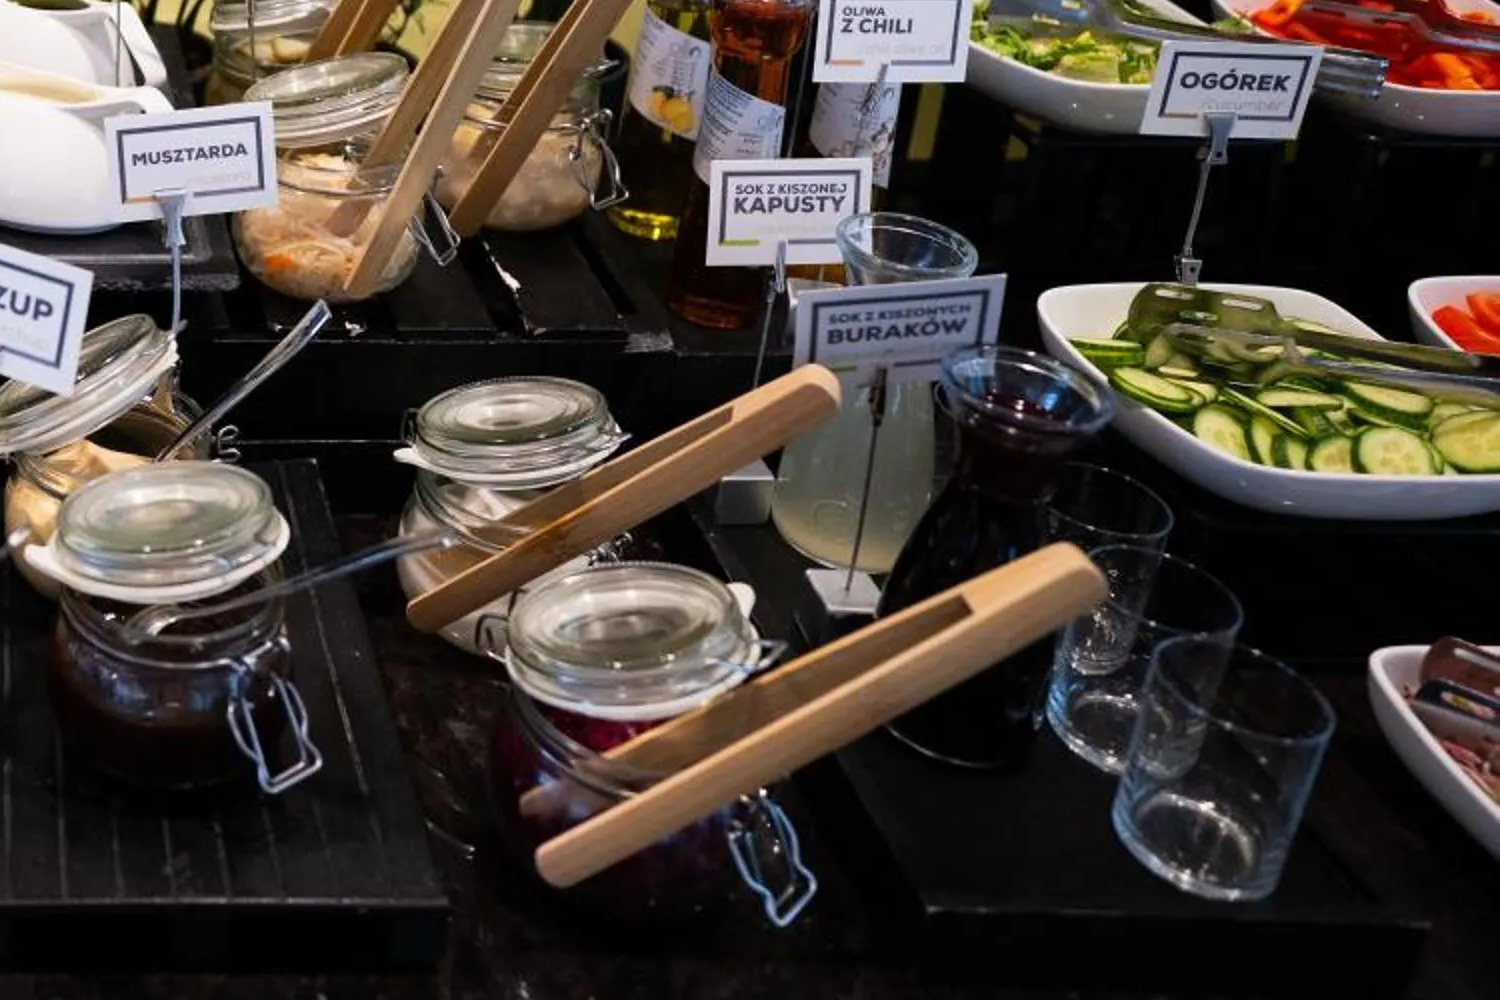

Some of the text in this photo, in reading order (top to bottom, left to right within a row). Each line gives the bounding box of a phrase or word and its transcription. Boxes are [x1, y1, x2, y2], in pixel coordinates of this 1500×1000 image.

[842, 6, 886, 17] OLIWA
[840, 18, 913, 34] Z CHILI
[1180, 68, 1292, 93] OGÓREK
[132, 143, 248, 167] MUSZTARDA
[735, 183, 848, 195] SOK Z KISZONEJ
[733, 195, 846, 215] KAPUSTY
[829, 303, 972, 326] SOK Z KISZONYCH
[827, 315, 967, 345] BURAKÓW
